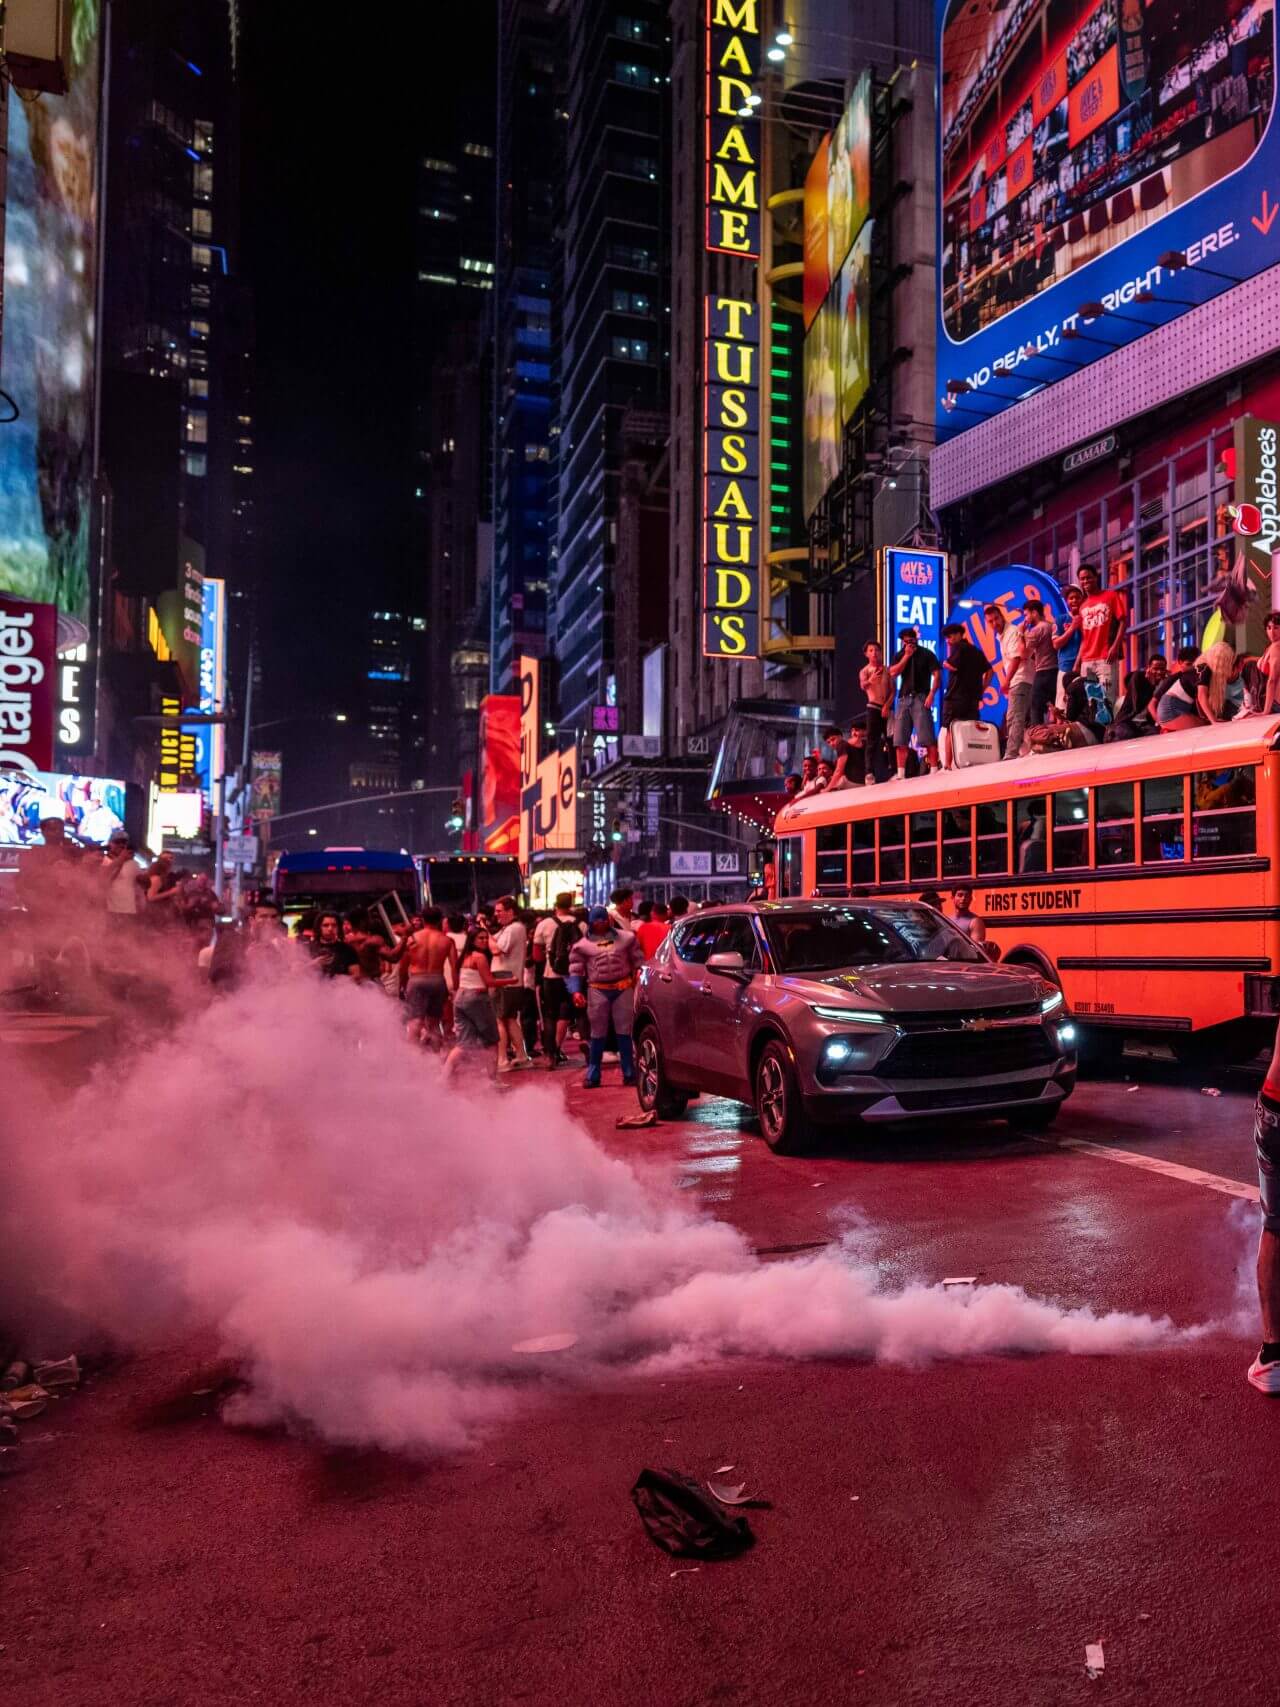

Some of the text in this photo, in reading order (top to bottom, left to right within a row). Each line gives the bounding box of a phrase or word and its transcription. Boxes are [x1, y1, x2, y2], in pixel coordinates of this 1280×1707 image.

[712, 0, 759, 655] MADAME TUSSAUD'S
[966, 367, 990, 393] NO
[1102, 264, 1164, 313] RIGHT
[1168, 222, 1240, 277] ERE.
[896, 594, 937, 625] EAT
[0, 611, 44, 745] target
[160, 697, 180, 765] VICTRY
[984, 888, 1082, 912] FIRST STUDENT
